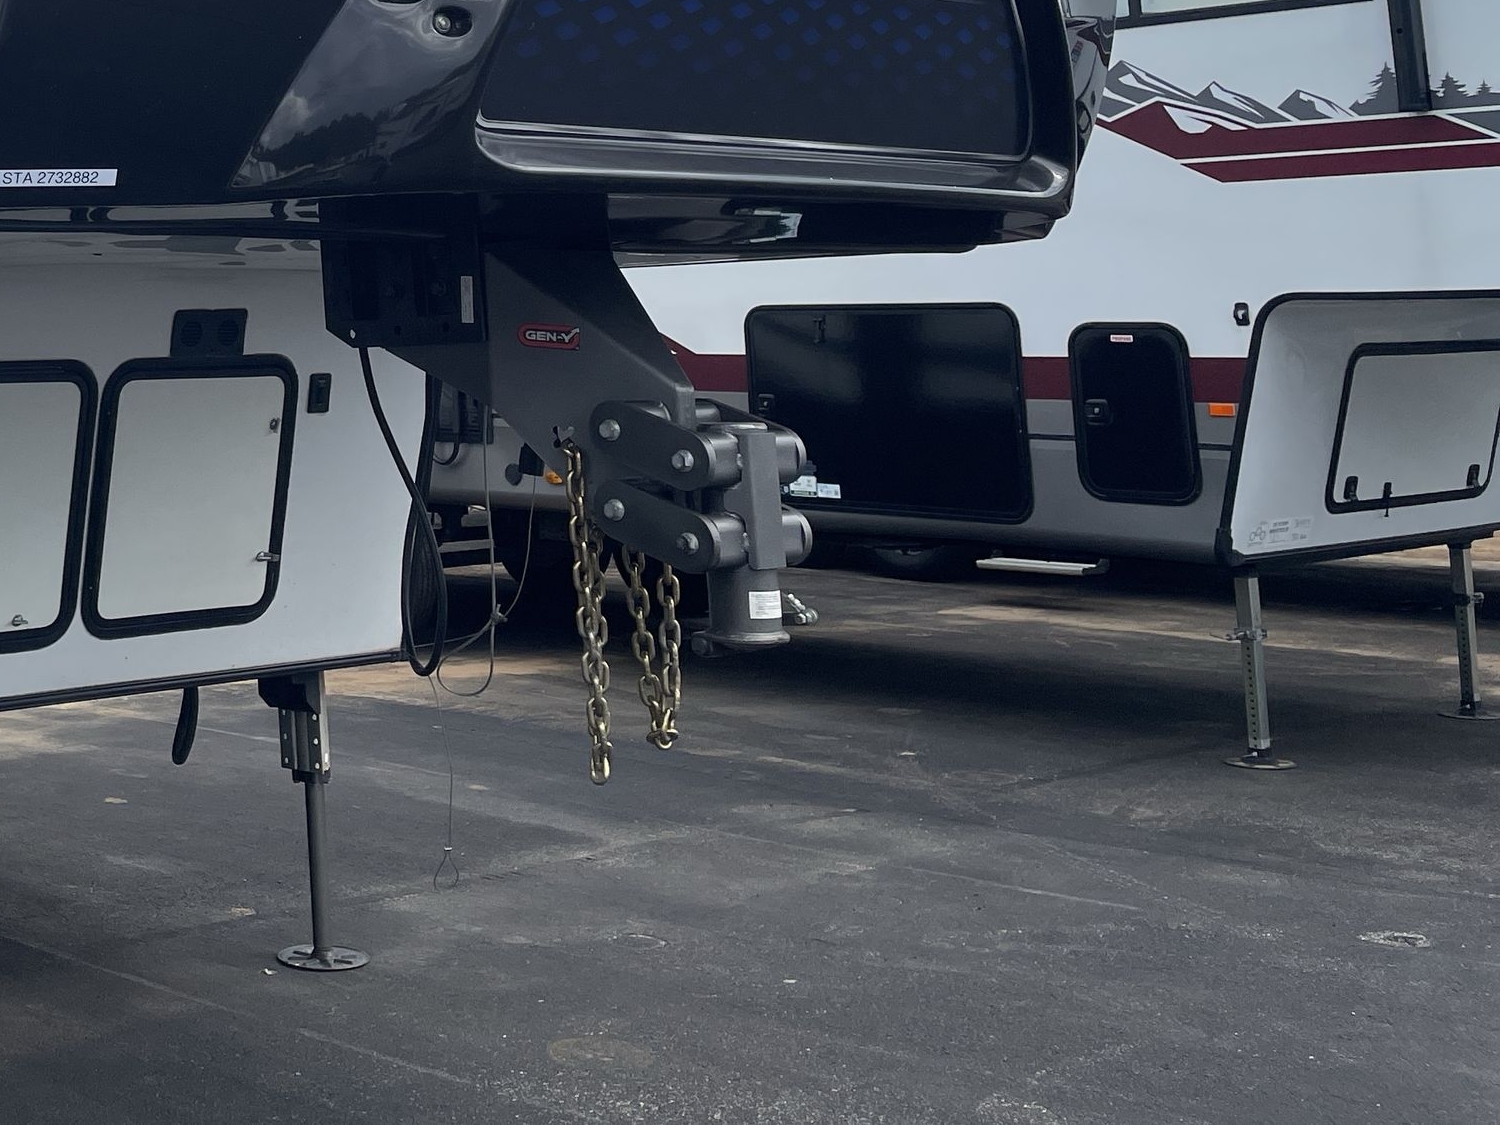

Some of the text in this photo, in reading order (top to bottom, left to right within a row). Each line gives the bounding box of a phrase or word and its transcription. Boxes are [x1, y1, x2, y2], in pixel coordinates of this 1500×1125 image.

[1, 170, 100, 185] STA 2732882
[525, 327, 580, 343] GEN-Y
